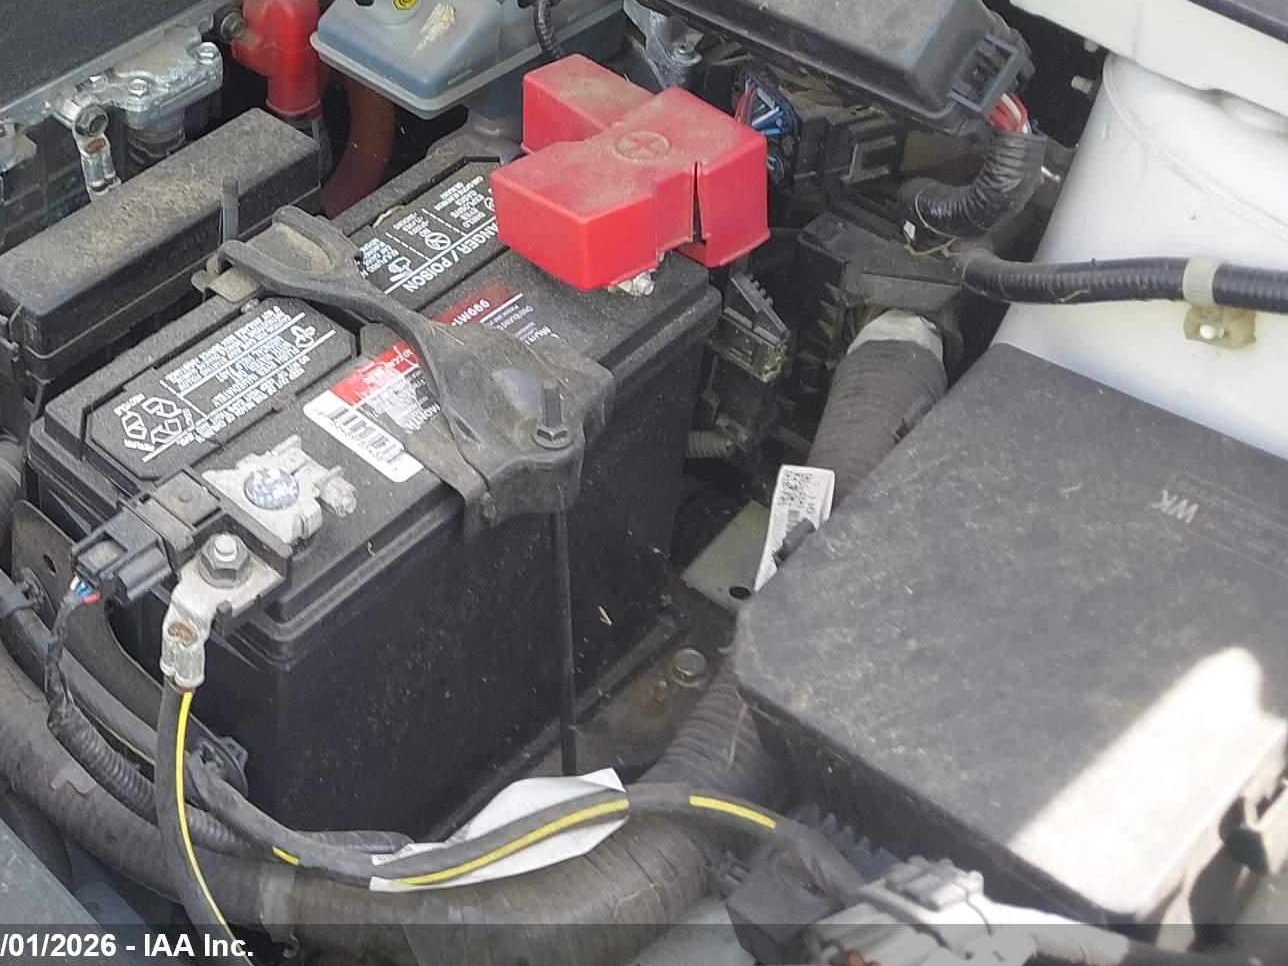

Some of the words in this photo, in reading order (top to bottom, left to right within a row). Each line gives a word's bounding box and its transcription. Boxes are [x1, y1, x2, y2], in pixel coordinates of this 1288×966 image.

[403, 257, 452, 292] POISON
[256, 361, 277, 376] EYES
[212, 373, 259, 406] IMMEDIATELY
